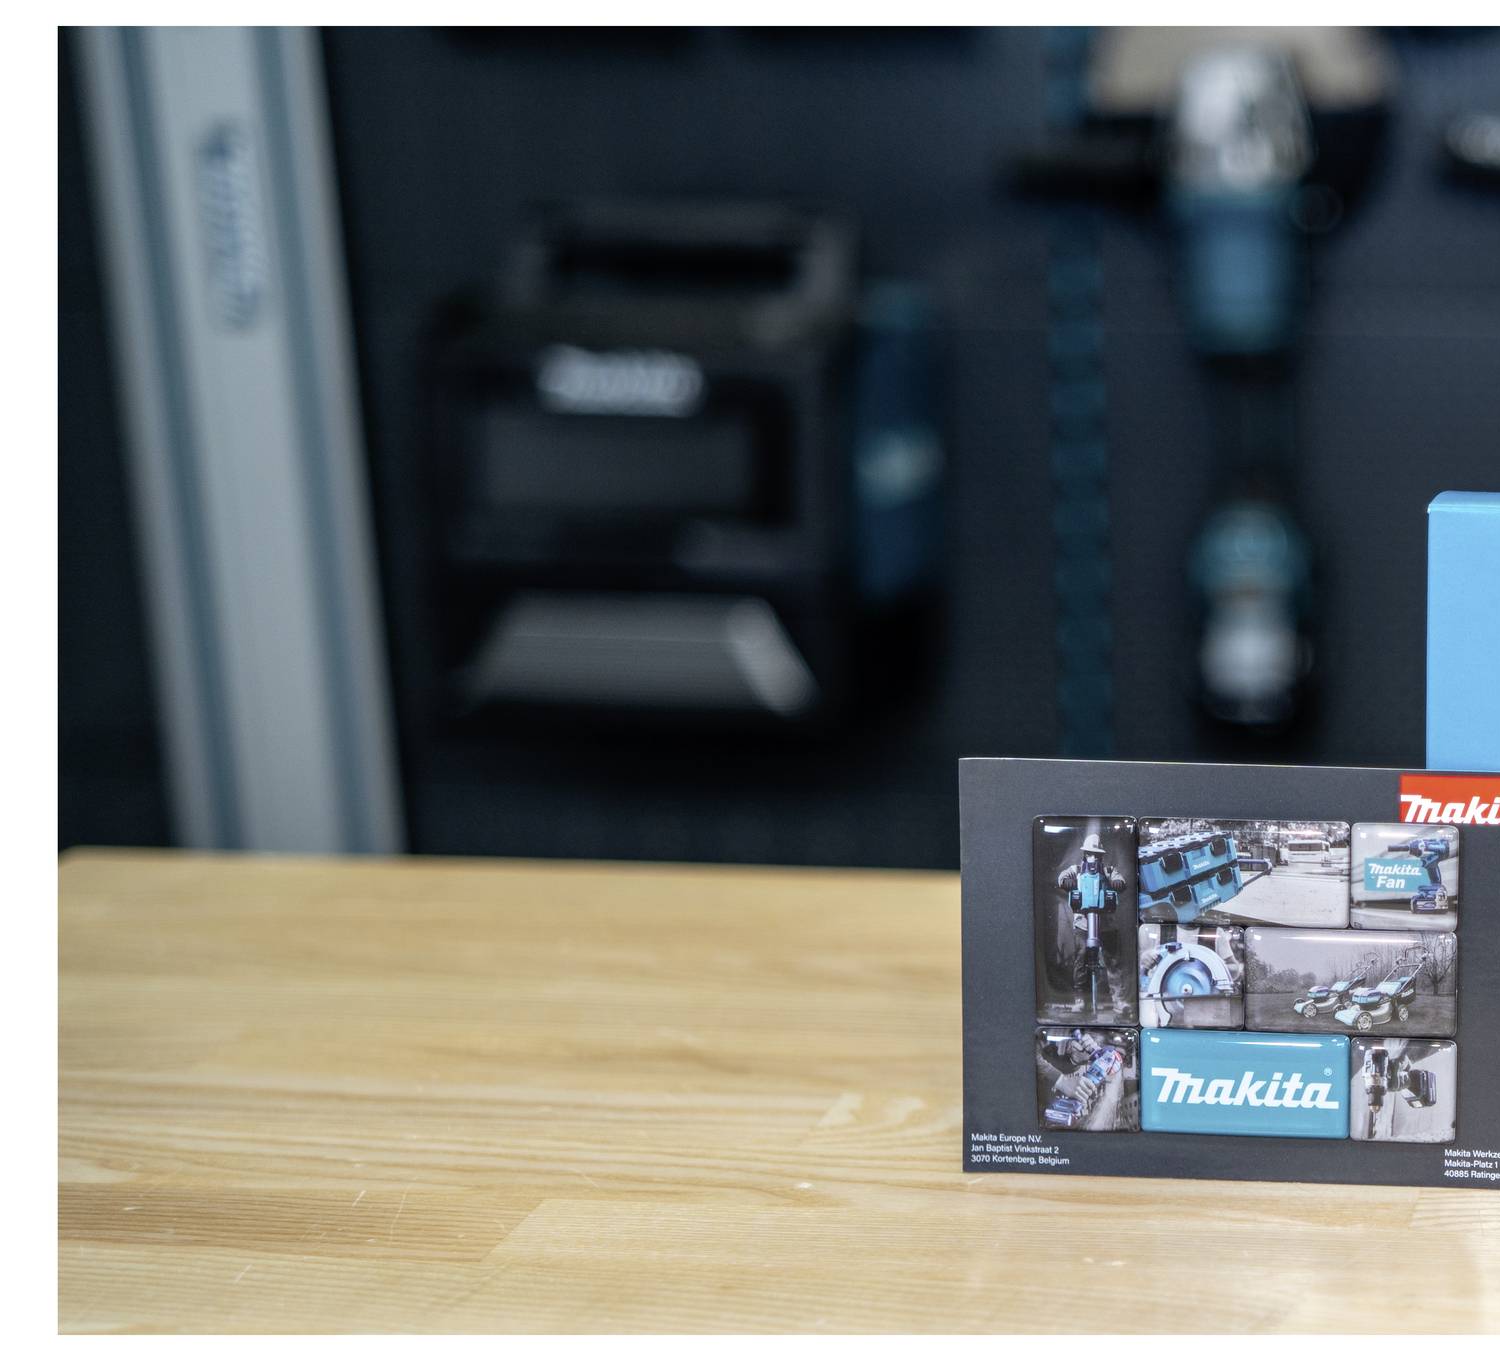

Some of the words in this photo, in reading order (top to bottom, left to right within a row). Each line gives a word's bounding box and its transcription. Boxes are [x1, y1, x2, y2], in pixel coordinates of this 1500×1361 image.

[1376, 876, 1405, 889] Fan
[971, 1133, 998, 1142] Makita
[999, 1133, 1026, 1143] Europe
[971, 1144, 984, 1152] Jan
[986, 1144, 1013, 1153] Baptist
[1014, 1145, 1052, 1154] Vinkstraat
[1054, 1146, 1060, 1154] 2
[1444, 1149, 1471, 1158] Makita
[971, 1154, 991, 1163] 3070
[992, 1154, 1037, 1165] Kortenberg,
[1038, 1156, 1070, 1166] Belgium
[1444, 1159, 1493, 1169] Makita-Platz
[1494, 1161, 1499, 1169] 1
[1443, 1169, 1469, 1178] 40885
